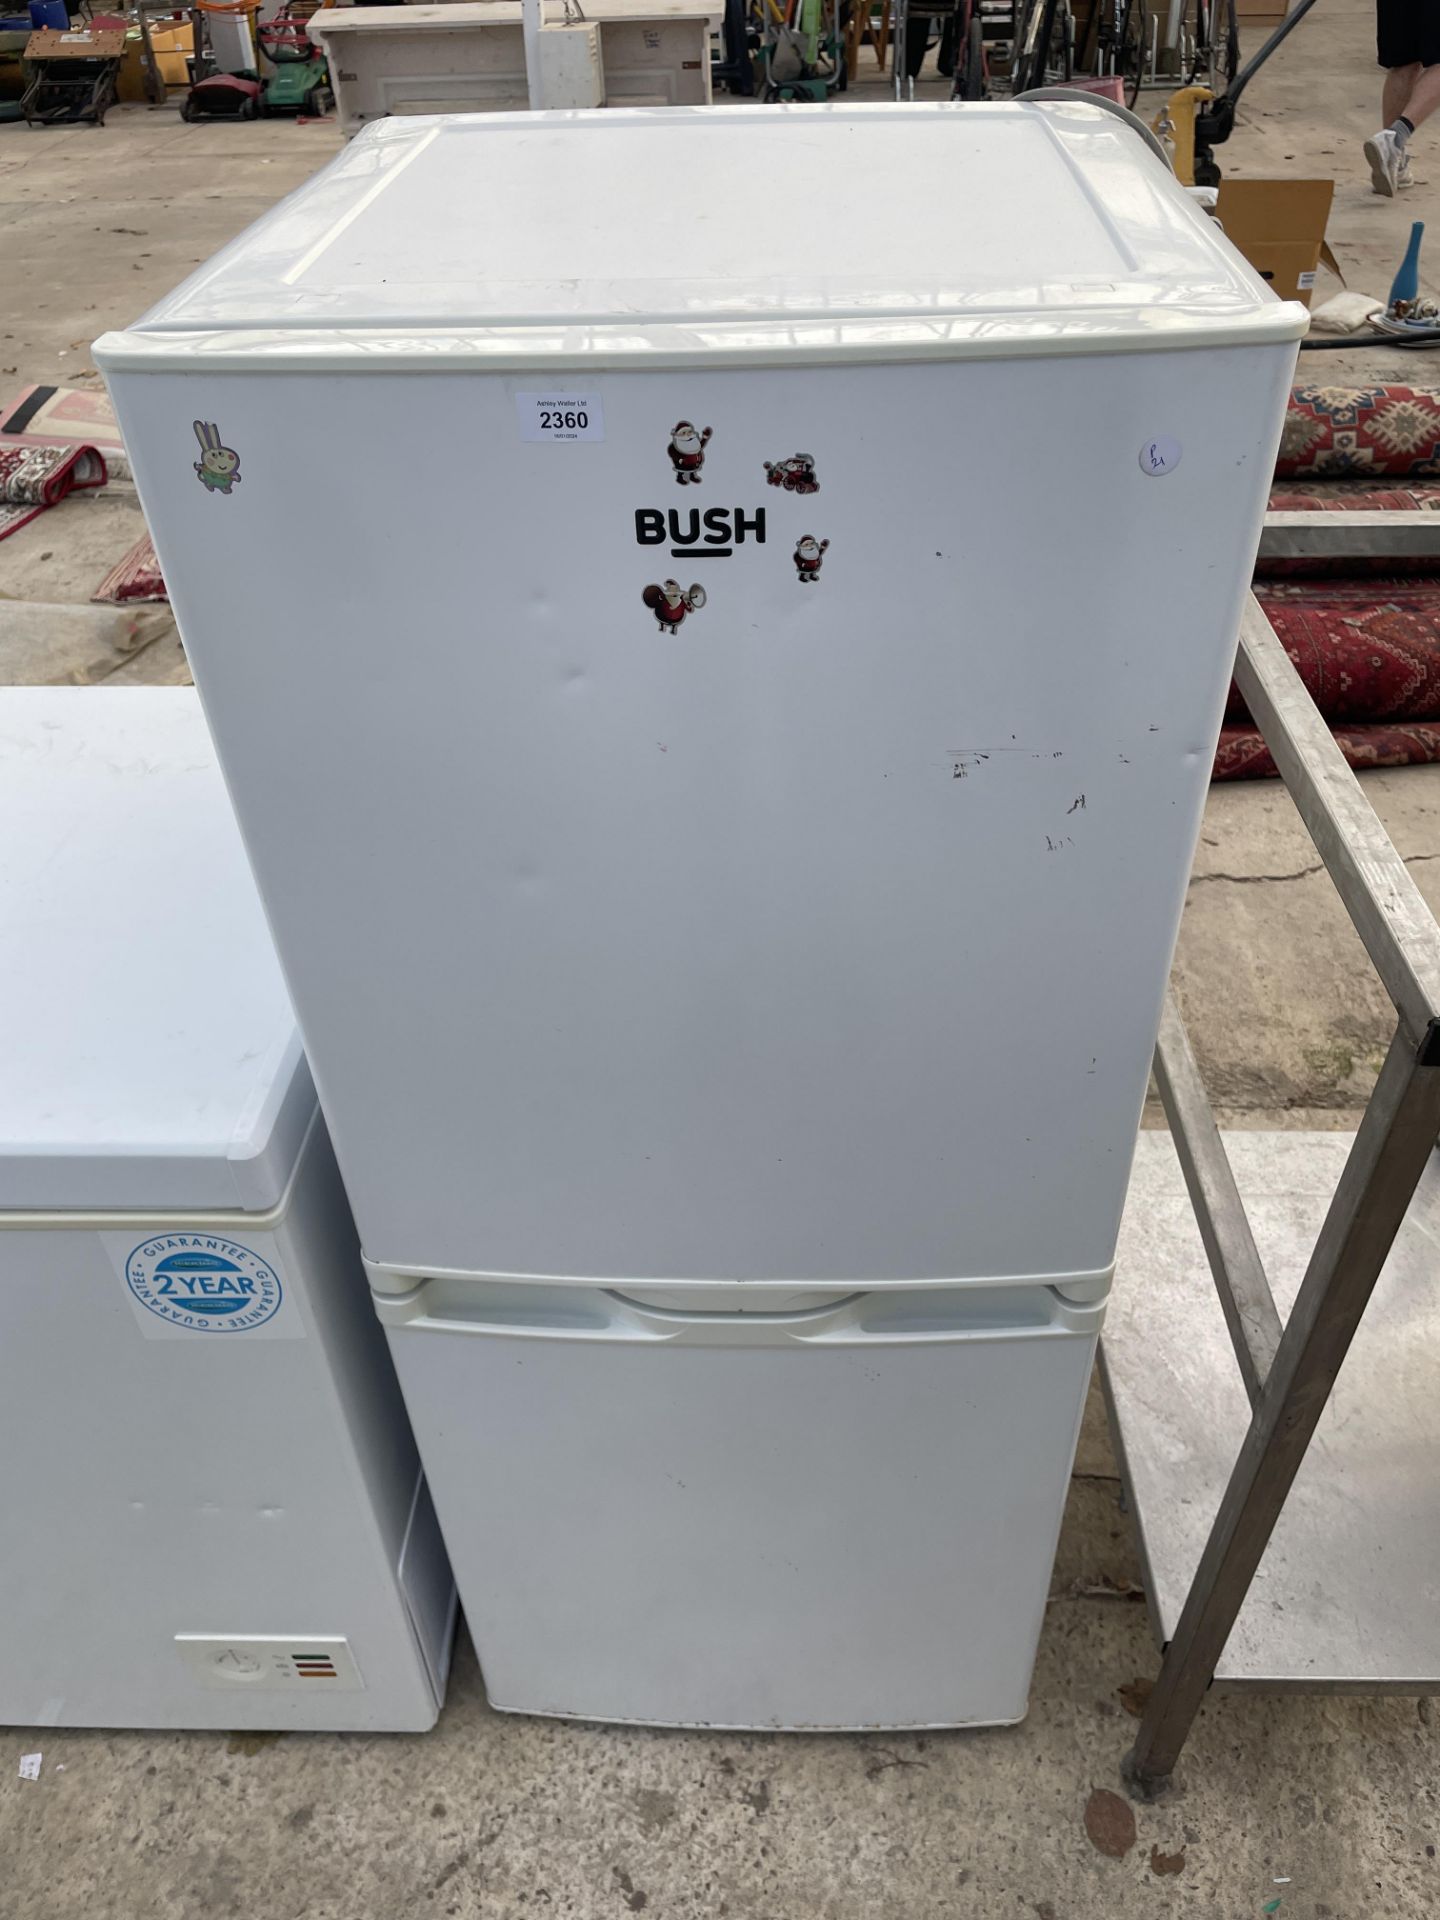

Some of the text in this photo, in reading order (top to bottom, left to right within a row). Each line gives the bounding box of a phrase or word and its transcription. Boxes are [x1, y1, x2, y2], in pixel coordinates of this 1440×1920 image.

[536, 400, 556, 408] Ashley
[539, 411, 589, 429] 2360
[635, 507, 766, 545] BUSH
[143, 1237, 248, 1262] GUARANTEE
[152, 1274, 258, 1295] 2 YEAR
[132, 1271, 209, 1328] GUARANTEE
[227, 1270, 275, 1328] GUARANTEE
